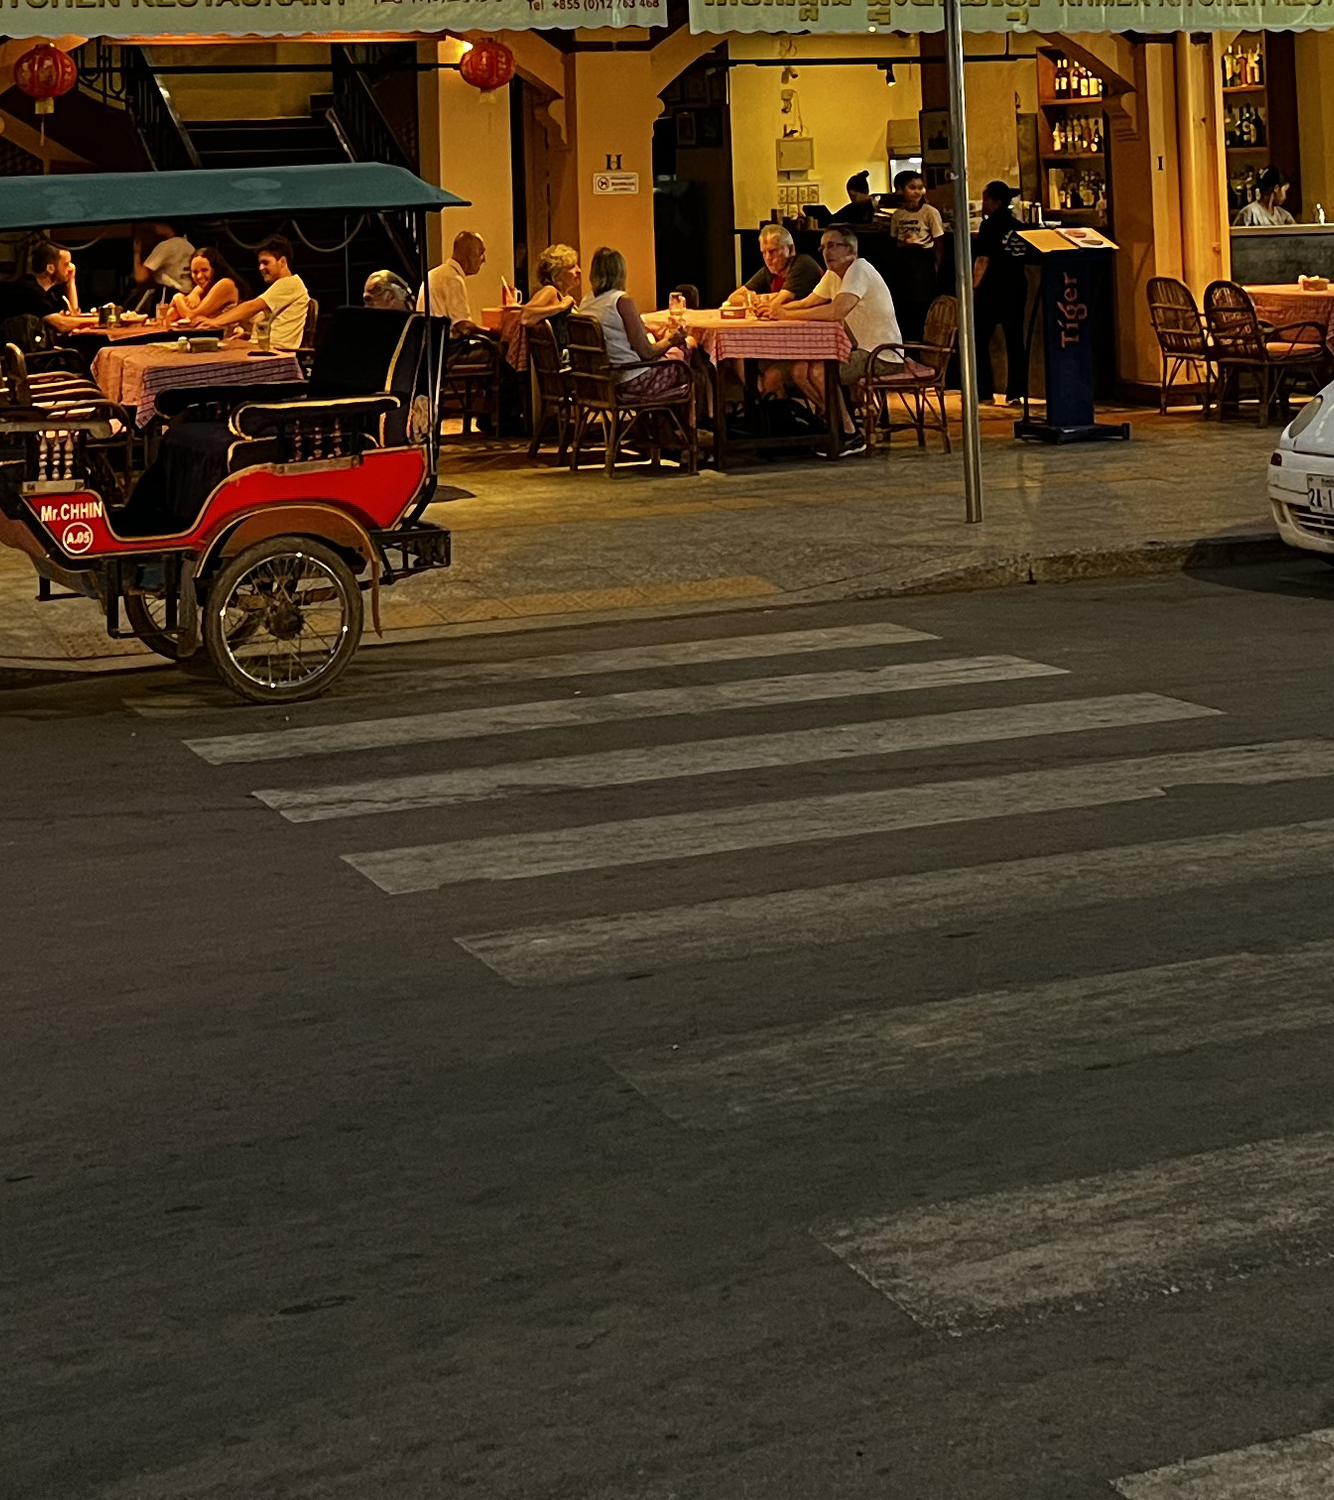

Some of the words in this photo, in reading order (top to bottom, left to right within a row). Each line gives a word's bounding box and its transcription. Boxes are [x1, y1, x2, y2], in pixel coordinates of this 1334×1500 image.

[606, 154, 623, 171] H
[1056, 271, 1088, 349] Tiger
[40, 501, 103, 522] Mr.CHHIN
